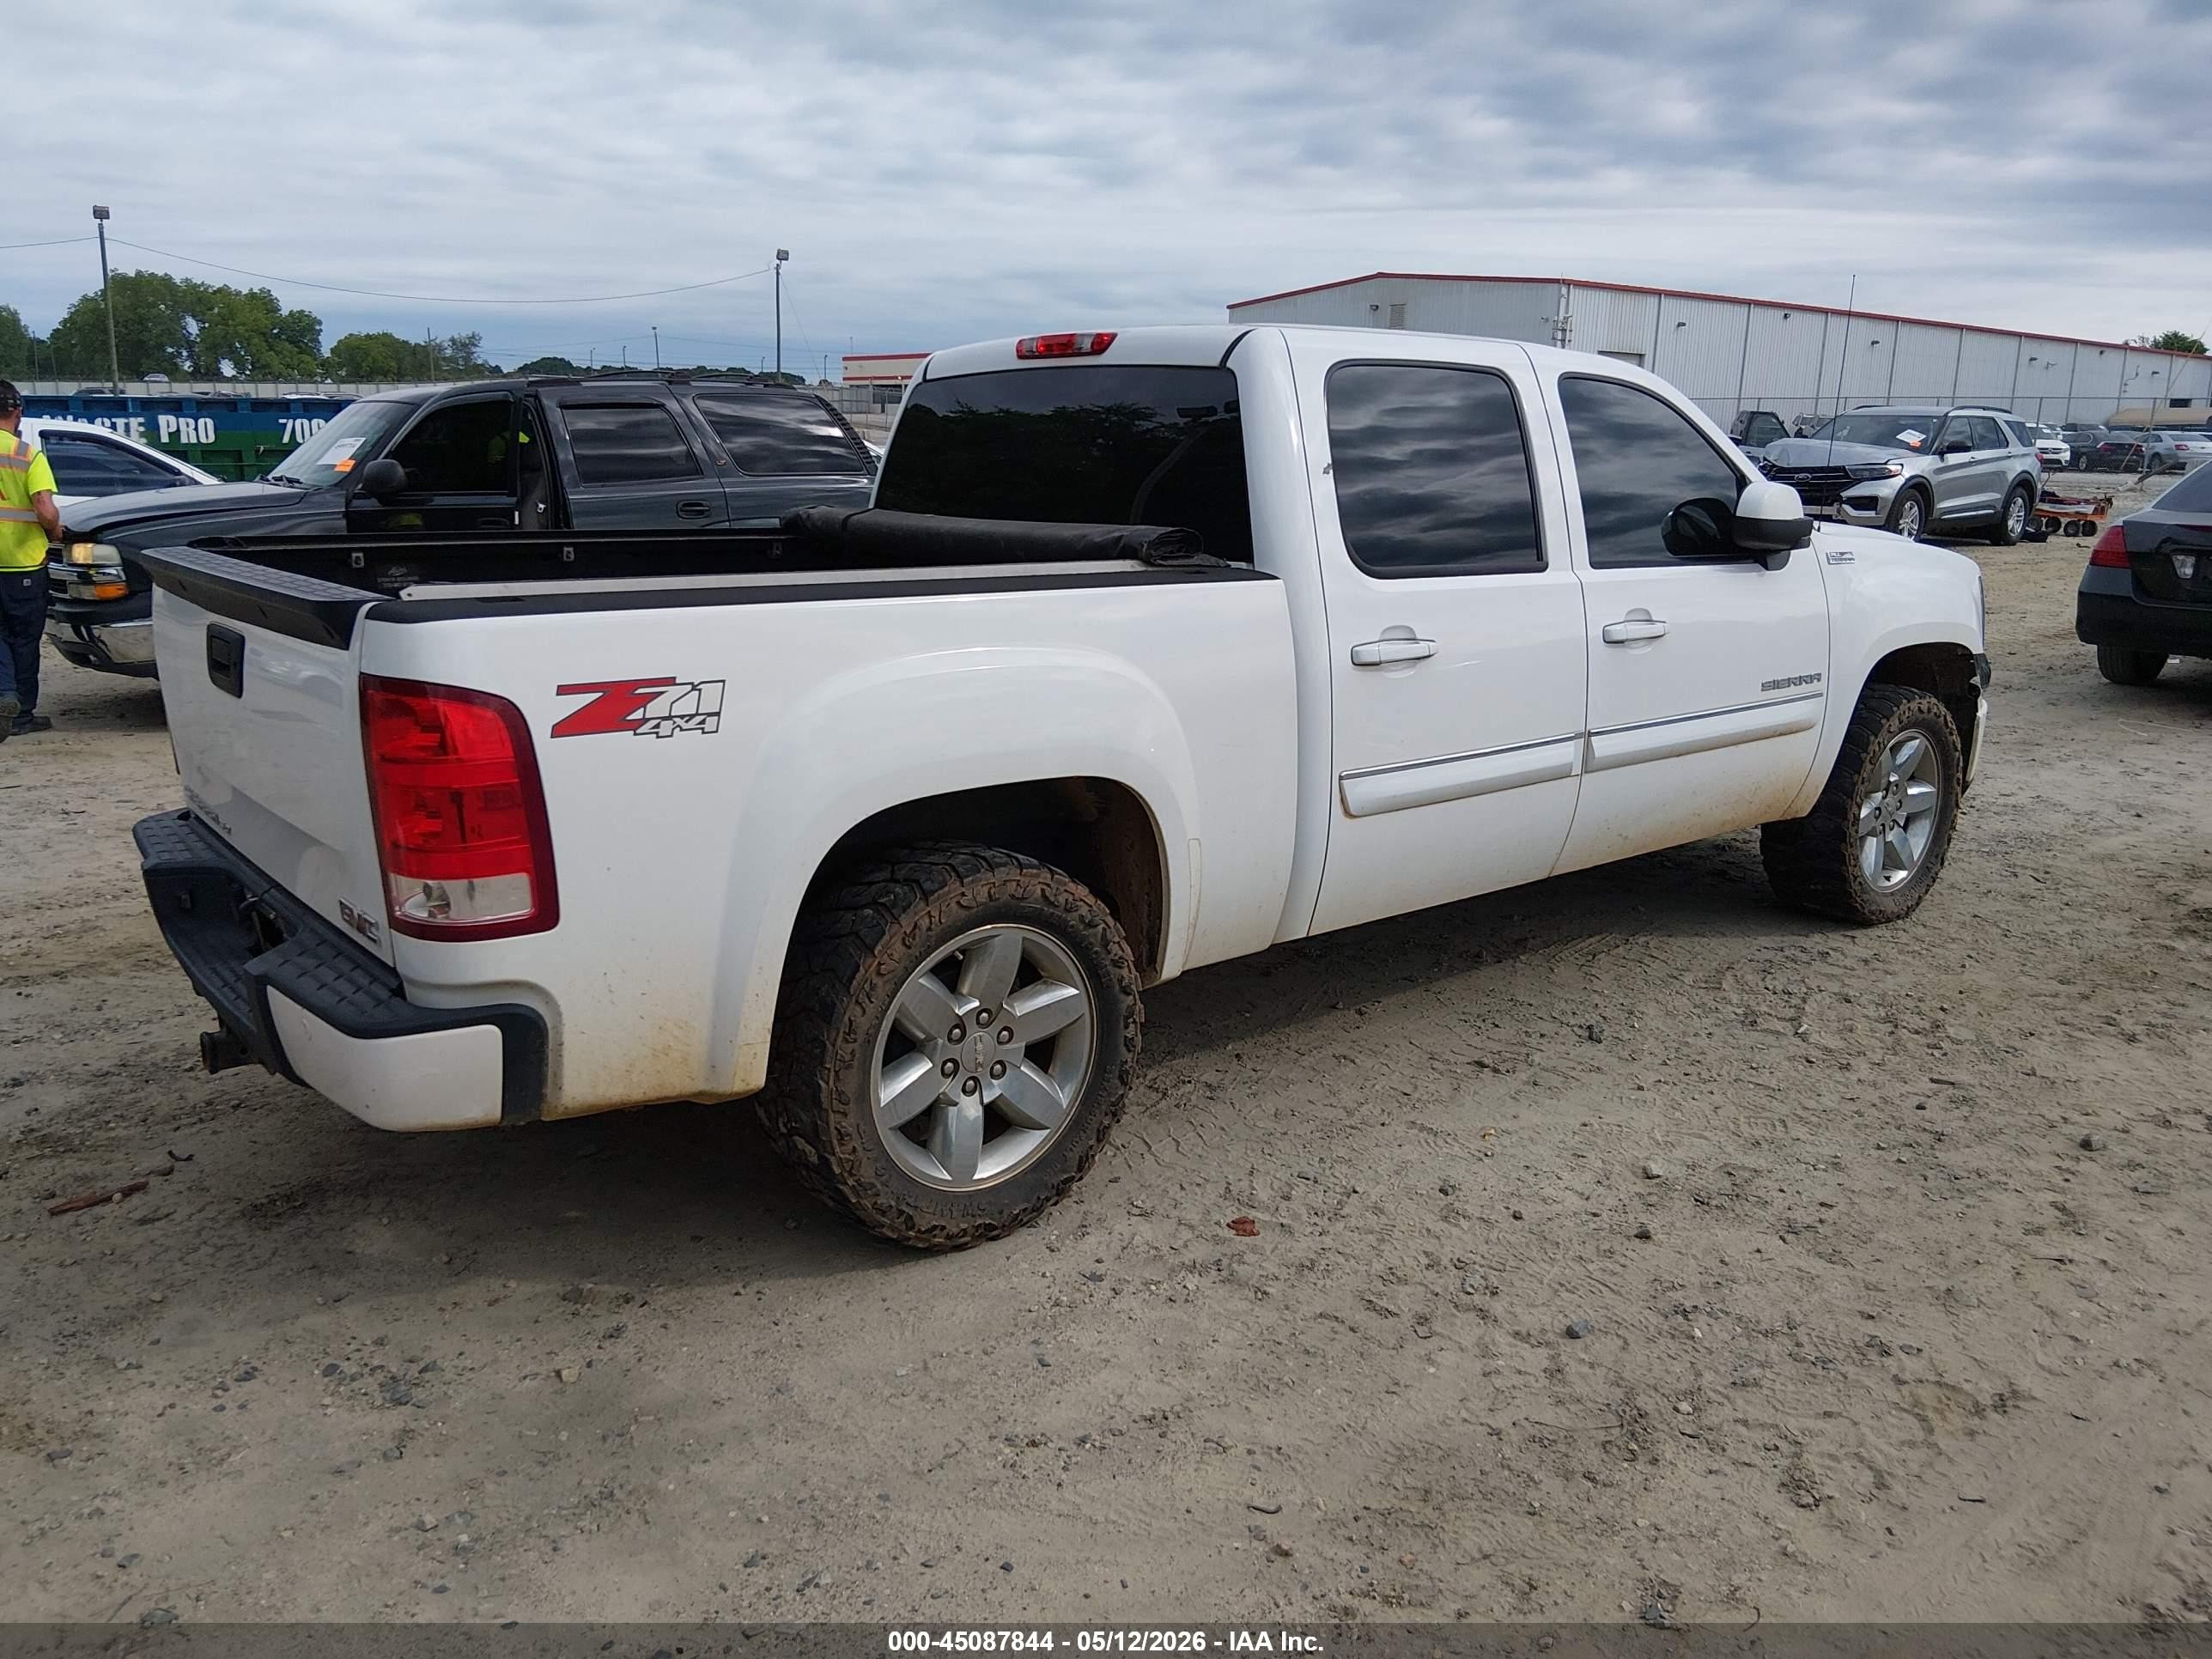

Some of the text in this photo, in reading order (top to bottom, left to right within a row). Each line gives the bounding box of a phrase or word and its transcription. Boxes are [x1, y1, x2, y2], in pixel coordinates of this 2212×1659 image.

[157, 414, 215, 444] PRO
[1760, 672, 1822, 692] SIERRA
[550, 676, 726, 738] Z71
[338, 897, 380, 944] GMC
